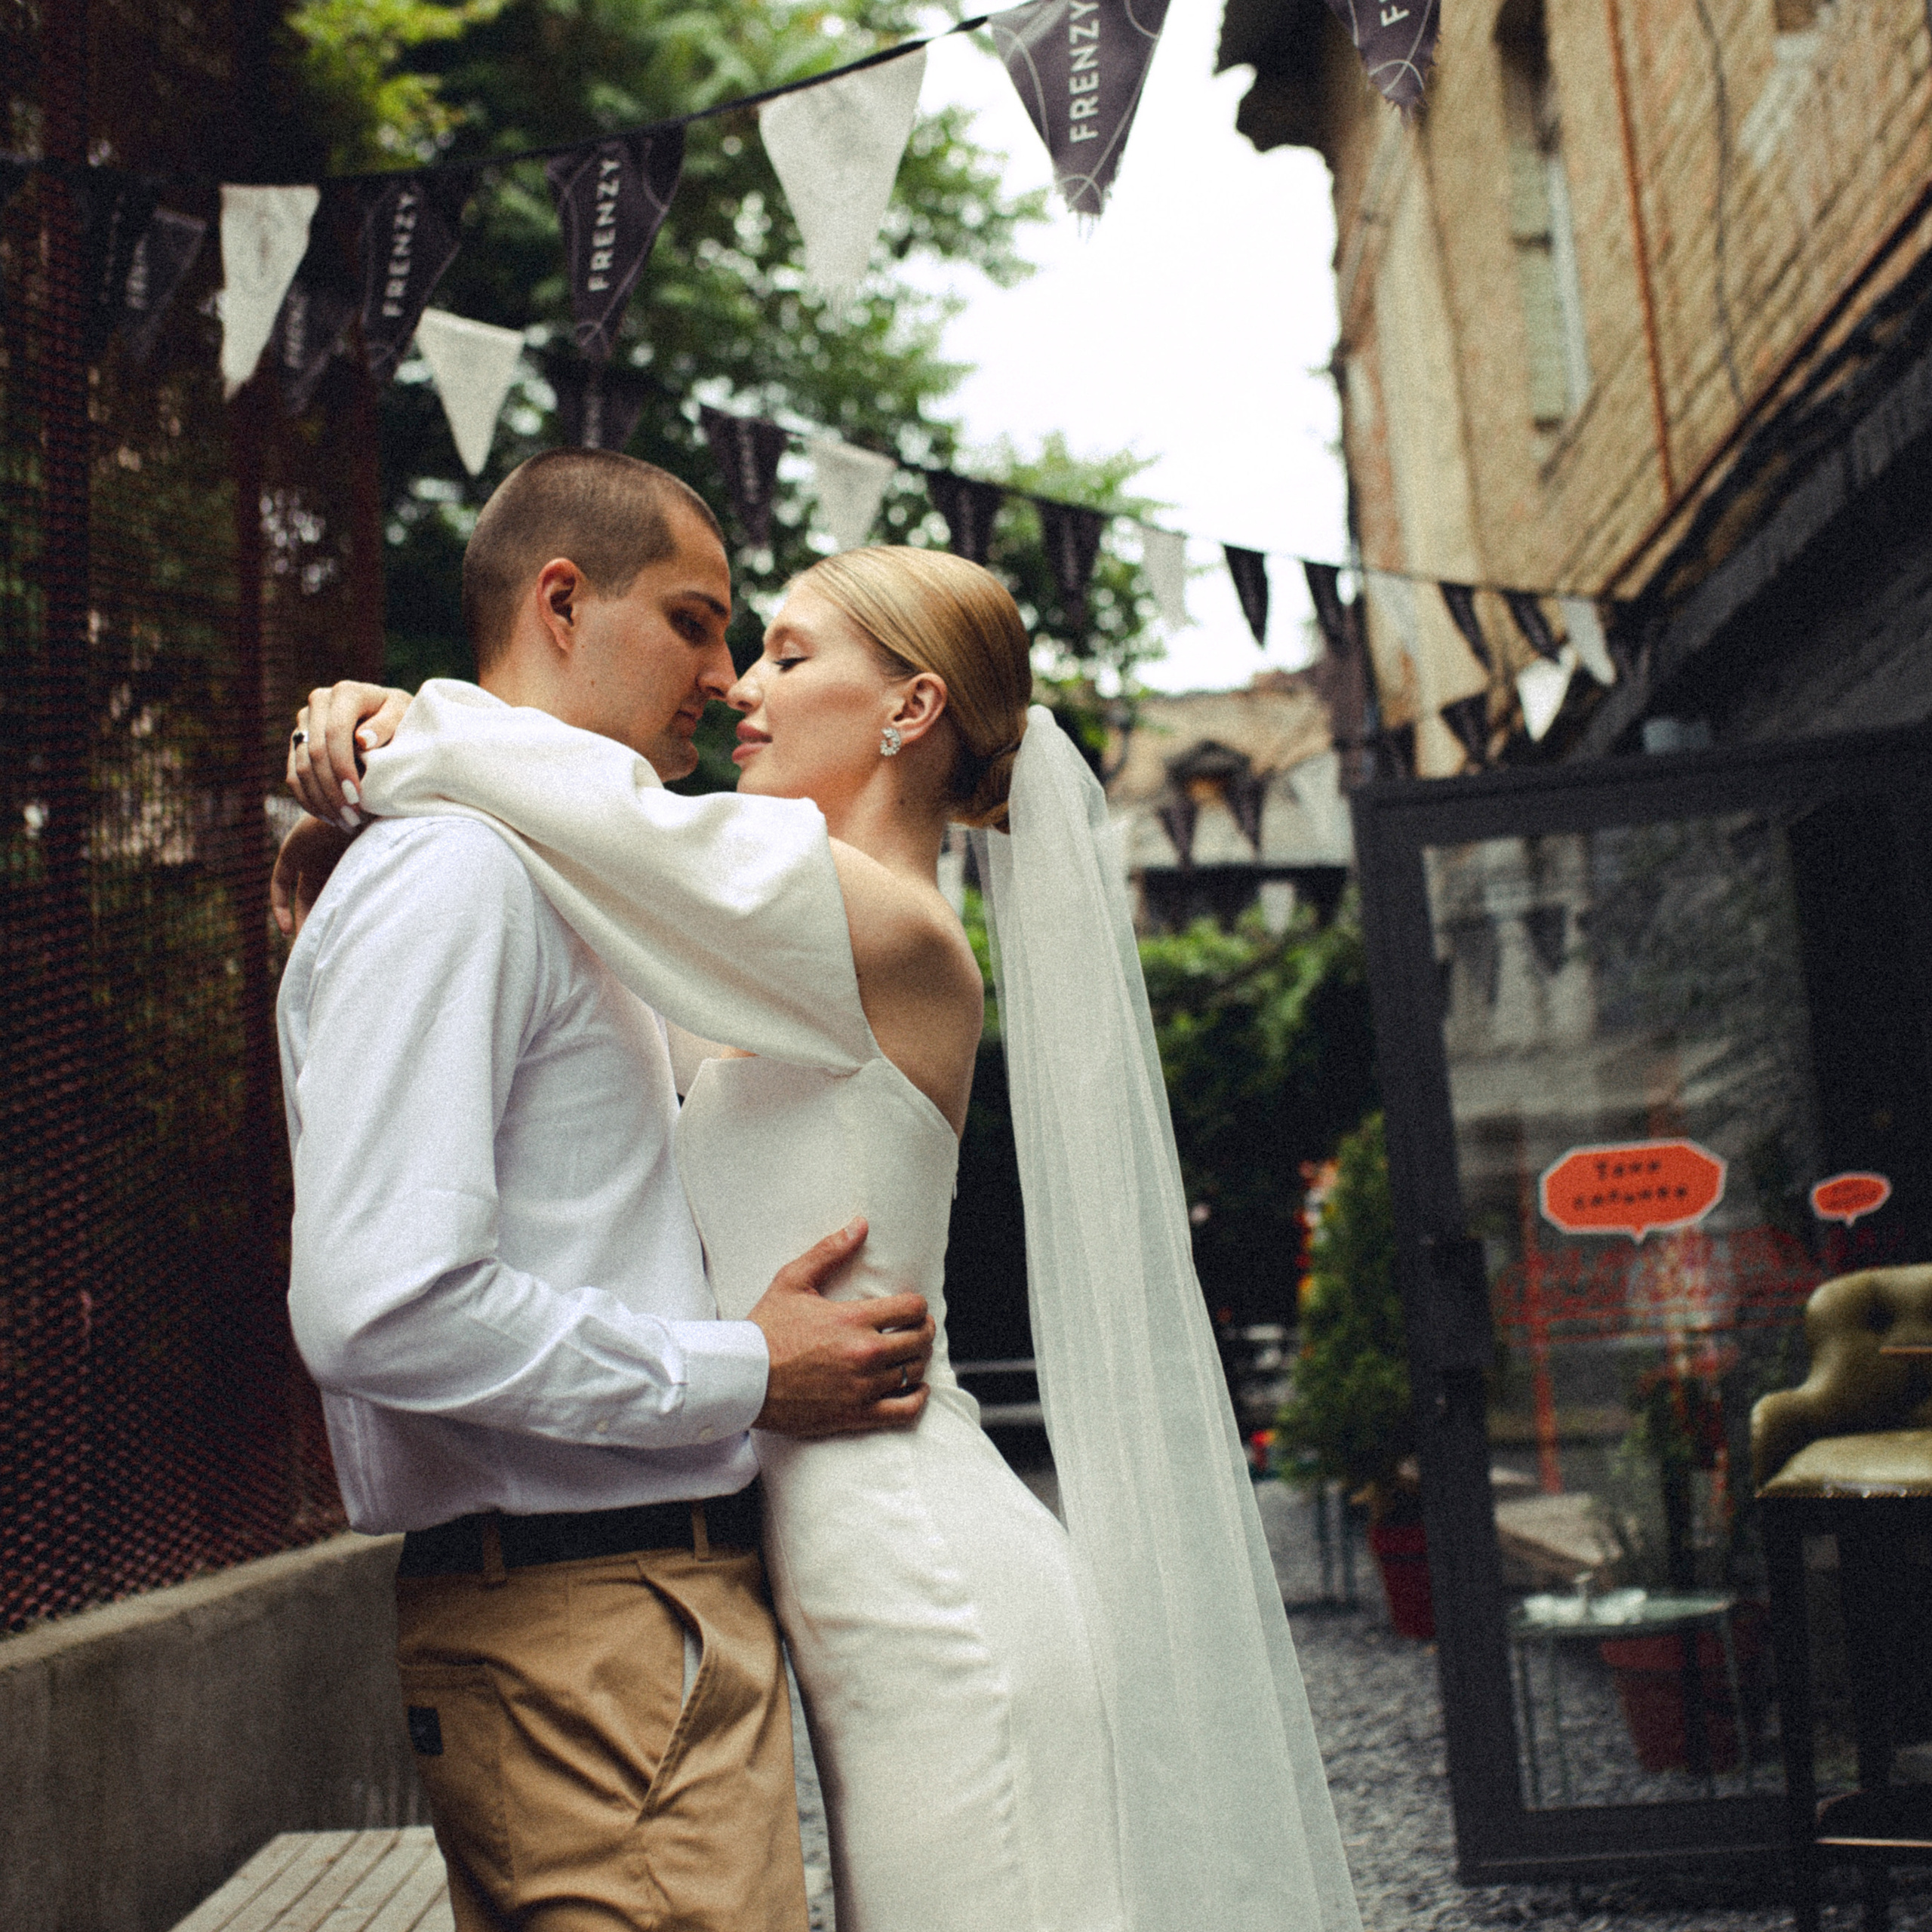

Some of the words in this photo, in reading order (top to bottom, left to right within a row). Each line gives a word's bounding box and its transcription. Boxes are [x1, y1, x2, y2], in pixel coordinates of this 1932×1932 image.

[1069, 0, 1100, 143] FRENZY
[1380, 0, 1410, 27] F
[382, 192, 416, 317] FRENZY
[587, 158, 621, 292] FRENZY
